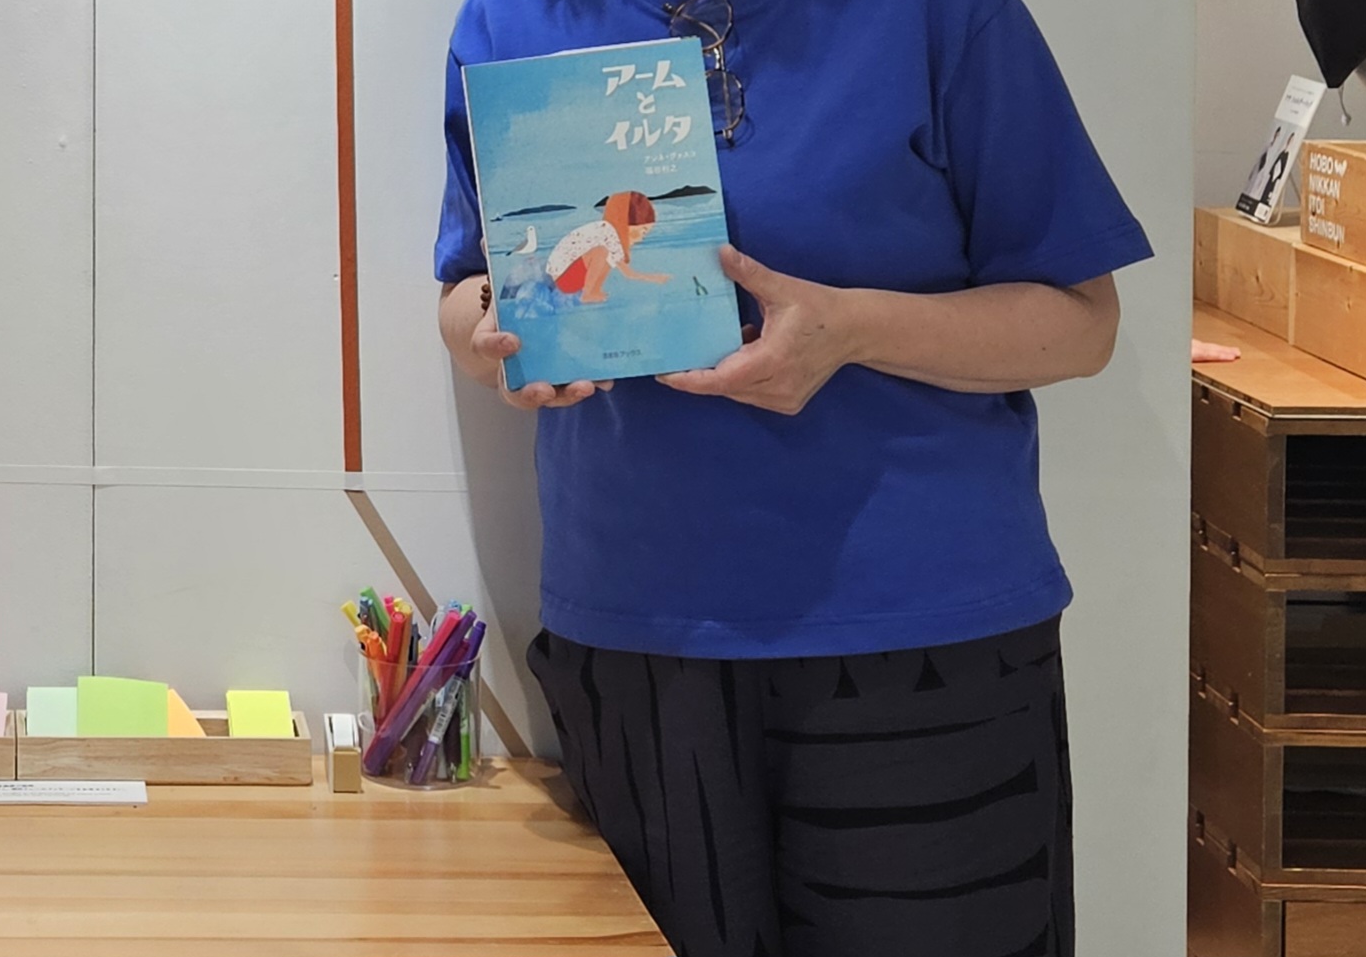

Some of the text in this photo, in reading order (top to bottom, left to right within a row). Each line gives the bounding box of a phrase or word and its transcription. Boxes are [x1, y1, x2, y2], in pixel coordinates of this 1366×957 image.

[602, 60, 687, 96] アーム
[636, 91, 656, 114] と
[604, 115, 692, 150] イルタ
[1309, 151, 1334, 175] HOBO
[1308, 173, 1341, 200] NIKKAN
[1308, 194, 1325, 215] ITOI
[1308, 216, 1345, 244] SHINBUN
